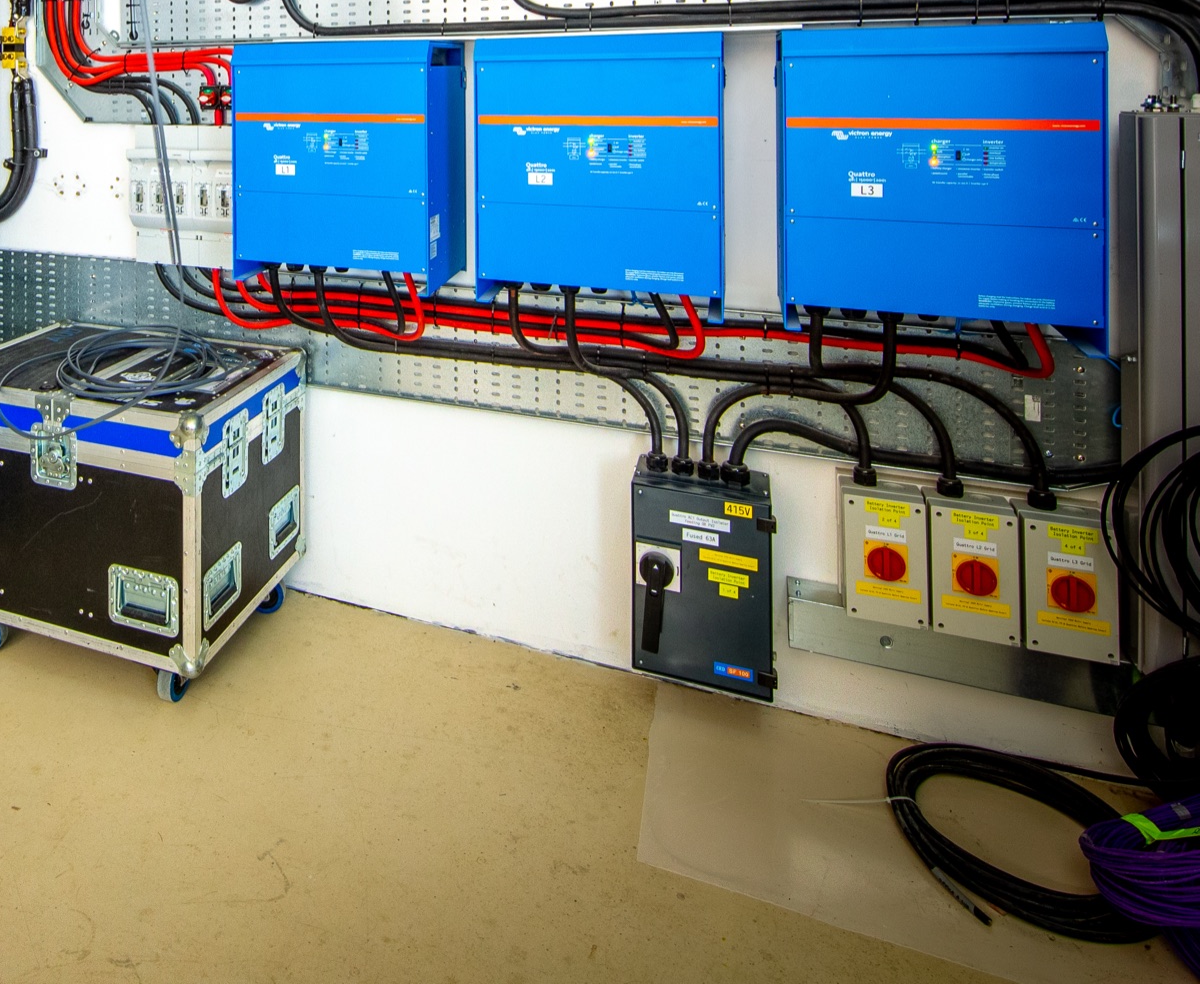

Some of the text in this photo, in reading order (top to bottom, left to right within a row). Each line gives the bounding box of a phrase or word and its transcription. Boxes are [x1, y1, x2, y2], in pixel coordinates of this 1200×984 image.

[525, 162, 547, 171] Quattro
[848, 170, 876, 179] Quattro
[535, 175, 546, 183] L2
[860, 185, 875, 196] L3
[727, 504, 751, 516] 415V
[953, 512, 972, 520] Battery
[1050, 526, 1070, 534] Battery
[686, 532, 703, 540] Fused
[1050, 556, 1070, 564] Quattro
